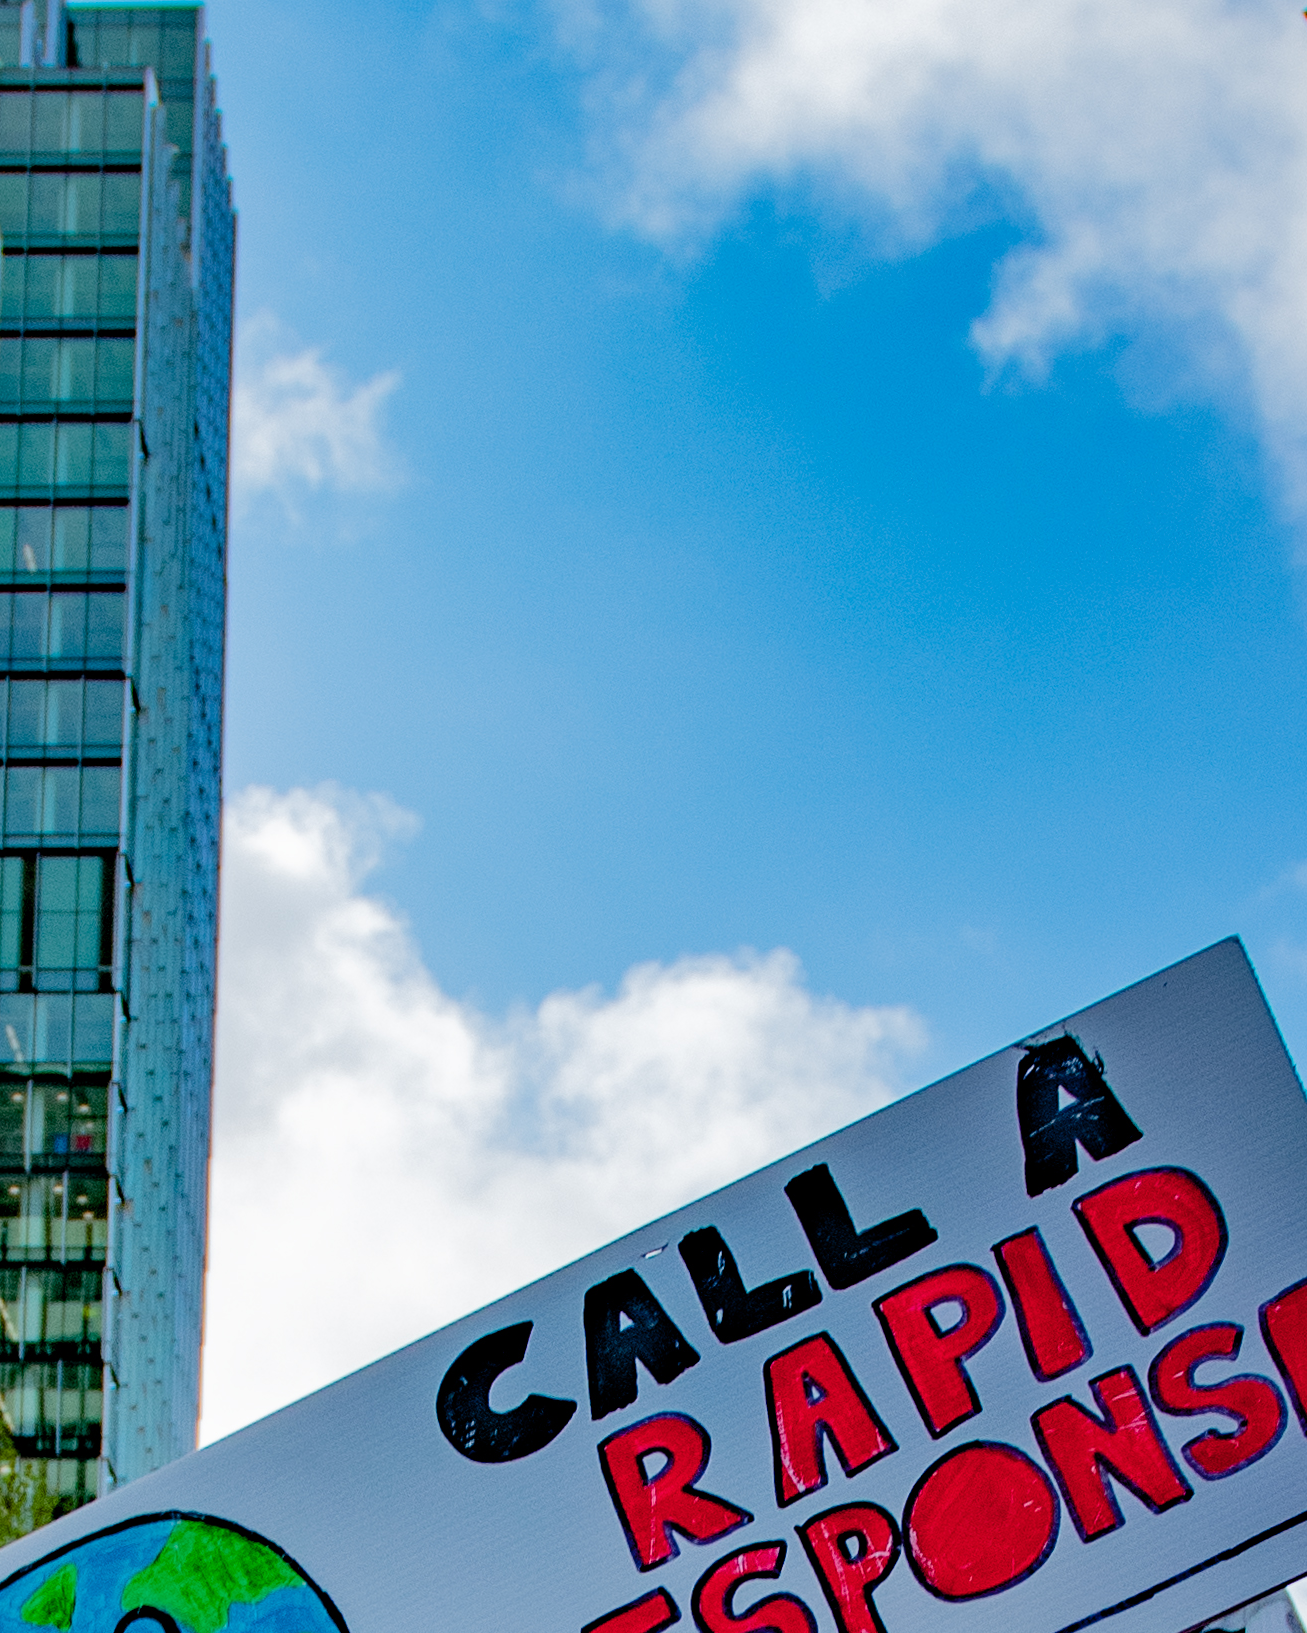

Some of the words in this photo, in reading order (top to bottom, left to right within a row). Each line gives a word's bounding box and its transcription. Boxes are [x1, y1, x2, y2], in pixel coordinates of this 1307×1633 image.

[435, 1162, 938, 1464] CALL
[1014, 1031, 1143, 1196] A
[598, 1165, 1229, 1572] RAPID
